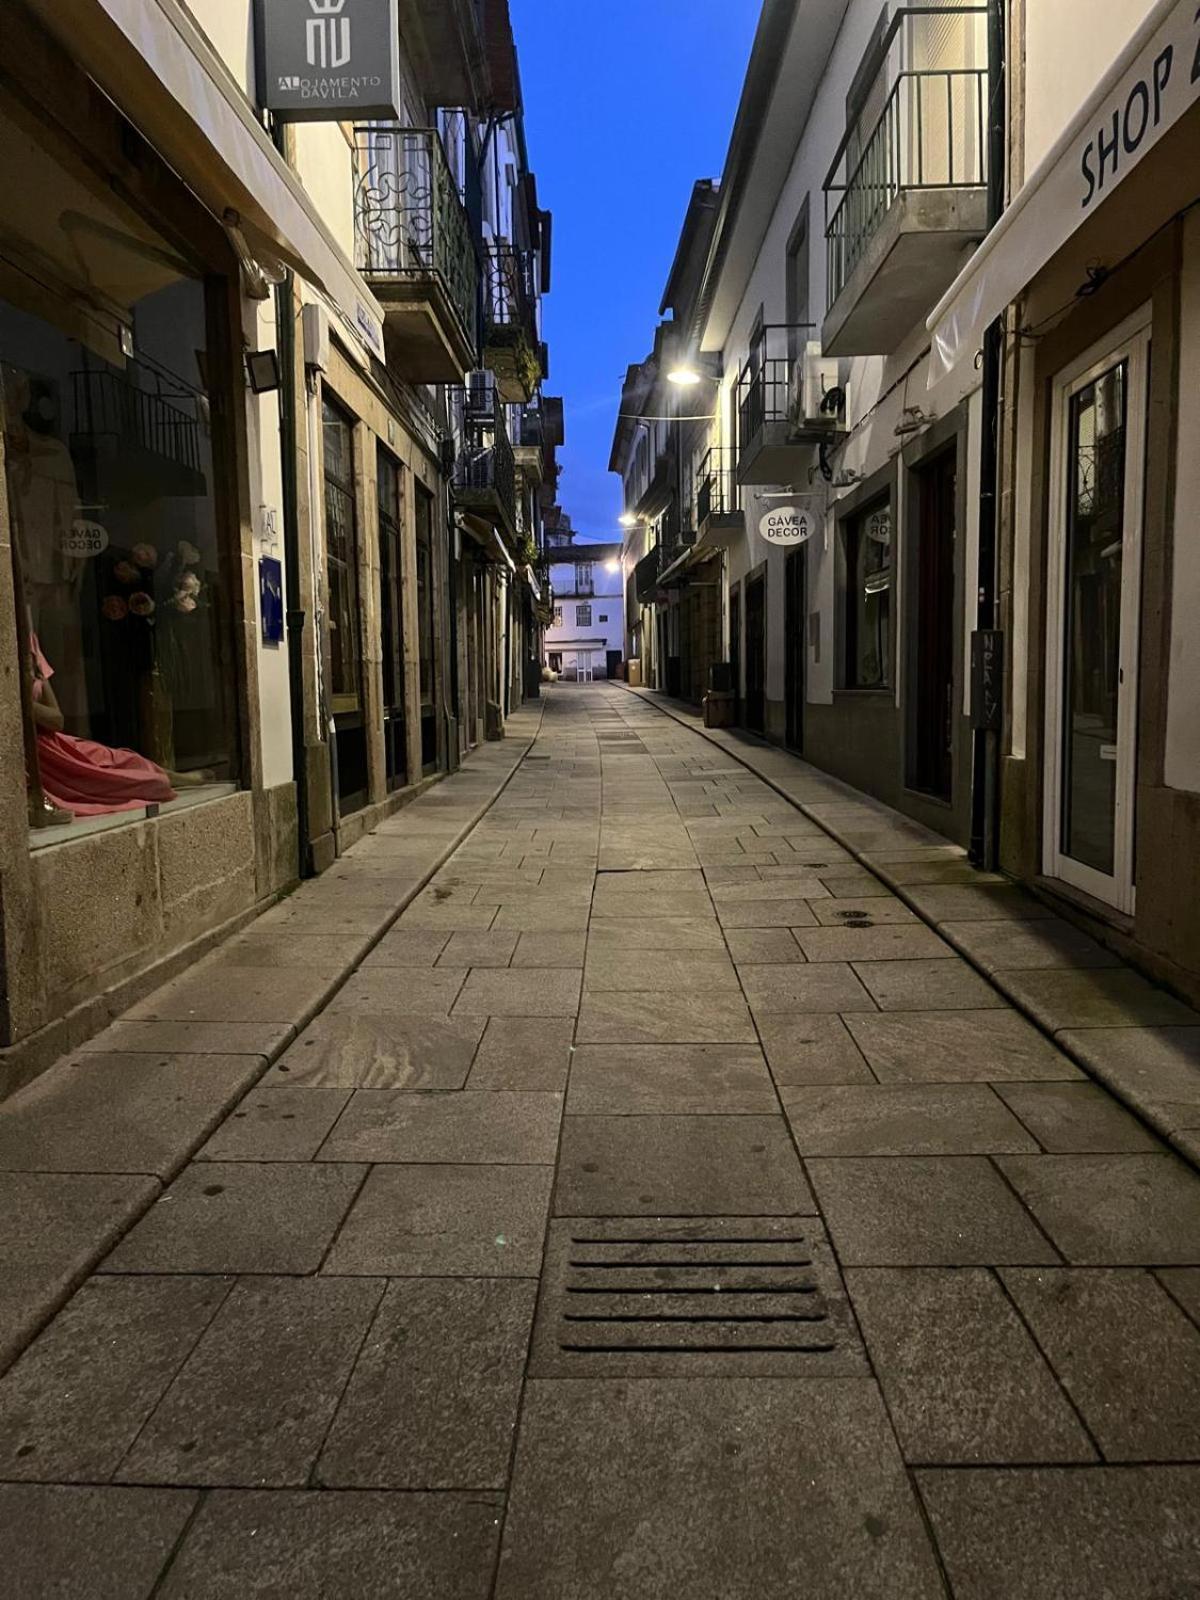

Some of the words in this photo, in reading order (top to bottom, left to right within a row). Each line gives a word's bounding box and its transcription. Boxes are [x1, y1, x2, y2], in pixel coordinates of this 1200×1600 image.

[278, 76, 381, 91] ALOJAMENTO
[1081, 44, 1173, 208] SHOP
[767, 527, 808, 538] DECOR
